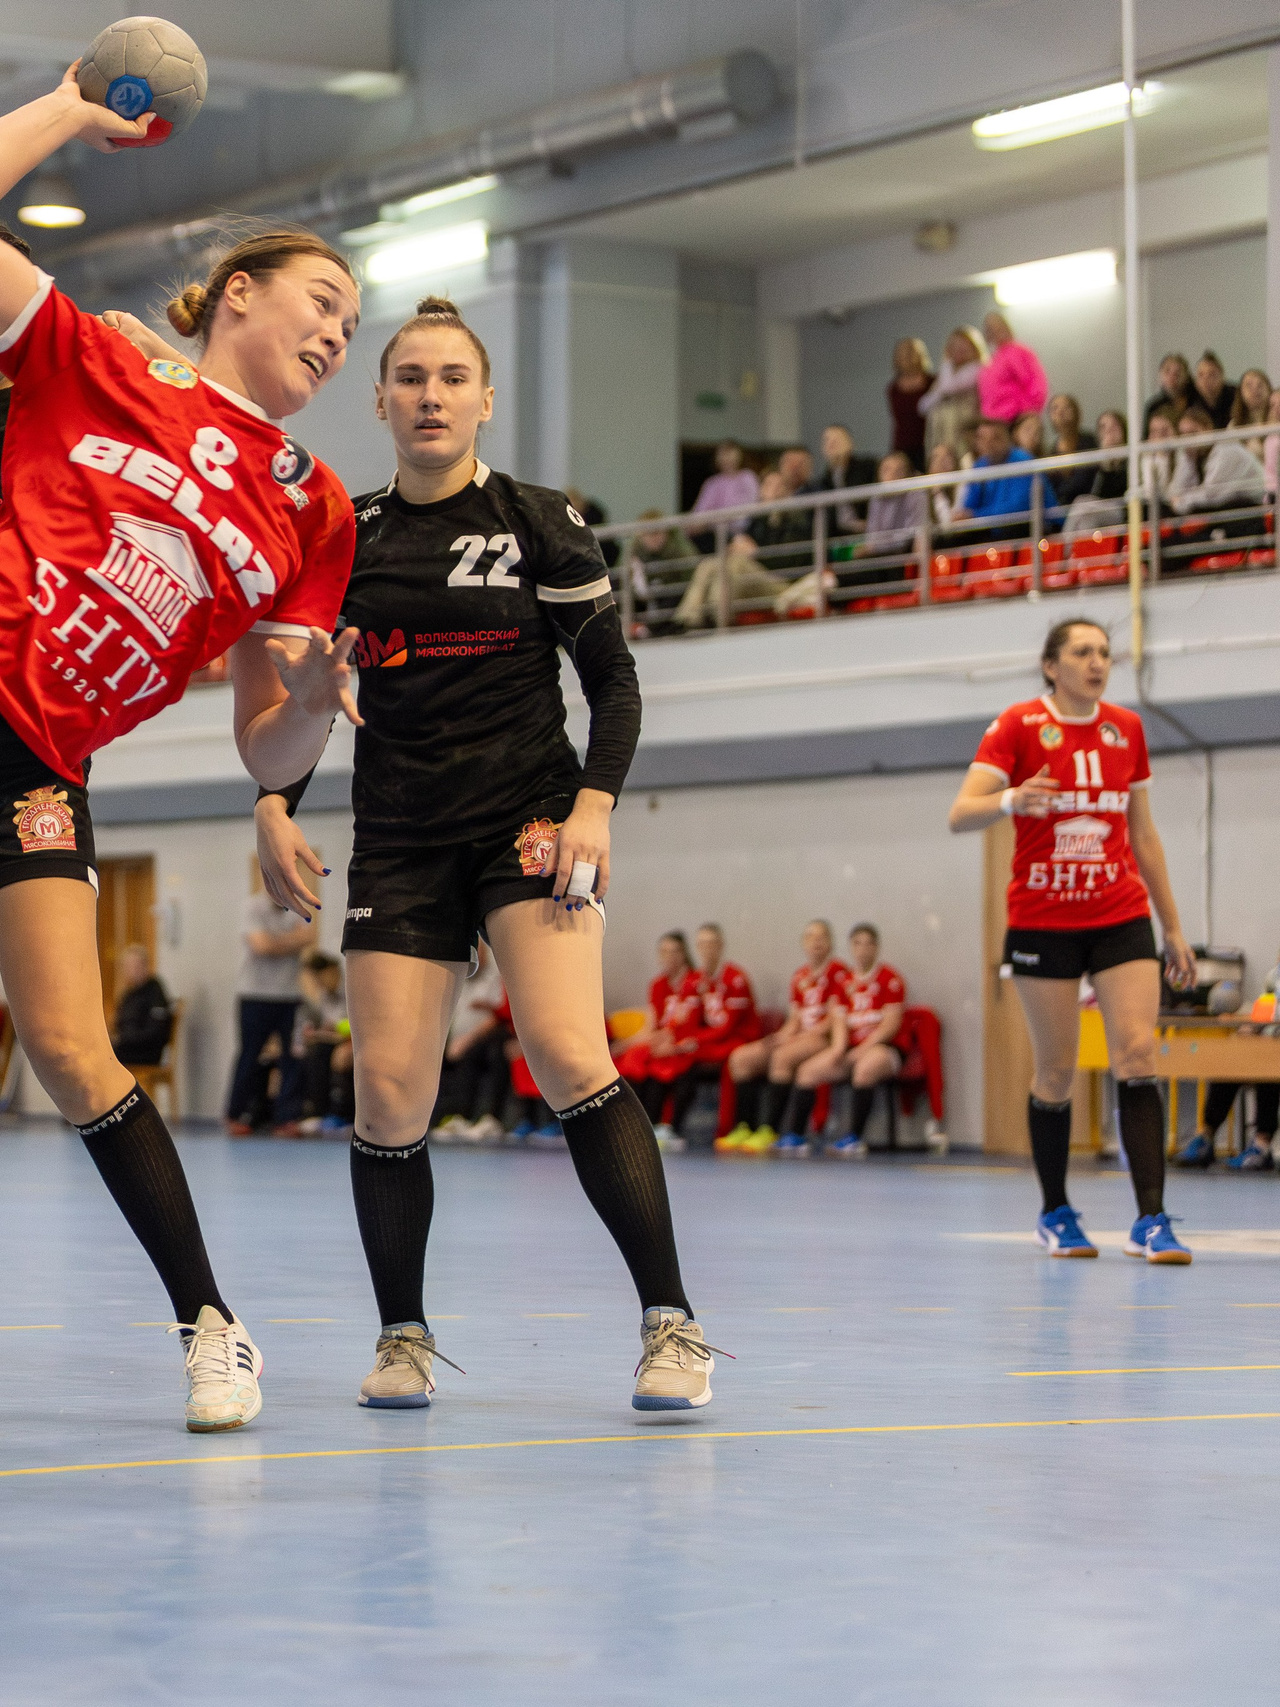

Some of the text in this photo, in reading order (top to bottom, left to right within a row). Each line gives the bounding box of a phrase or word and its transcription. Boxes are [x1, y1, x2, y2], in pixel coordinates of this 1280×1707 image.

[190, 427, 238, 490] 8
[447, 533, 521, 588] 22
[1073, 749, 1104, 788] 11
